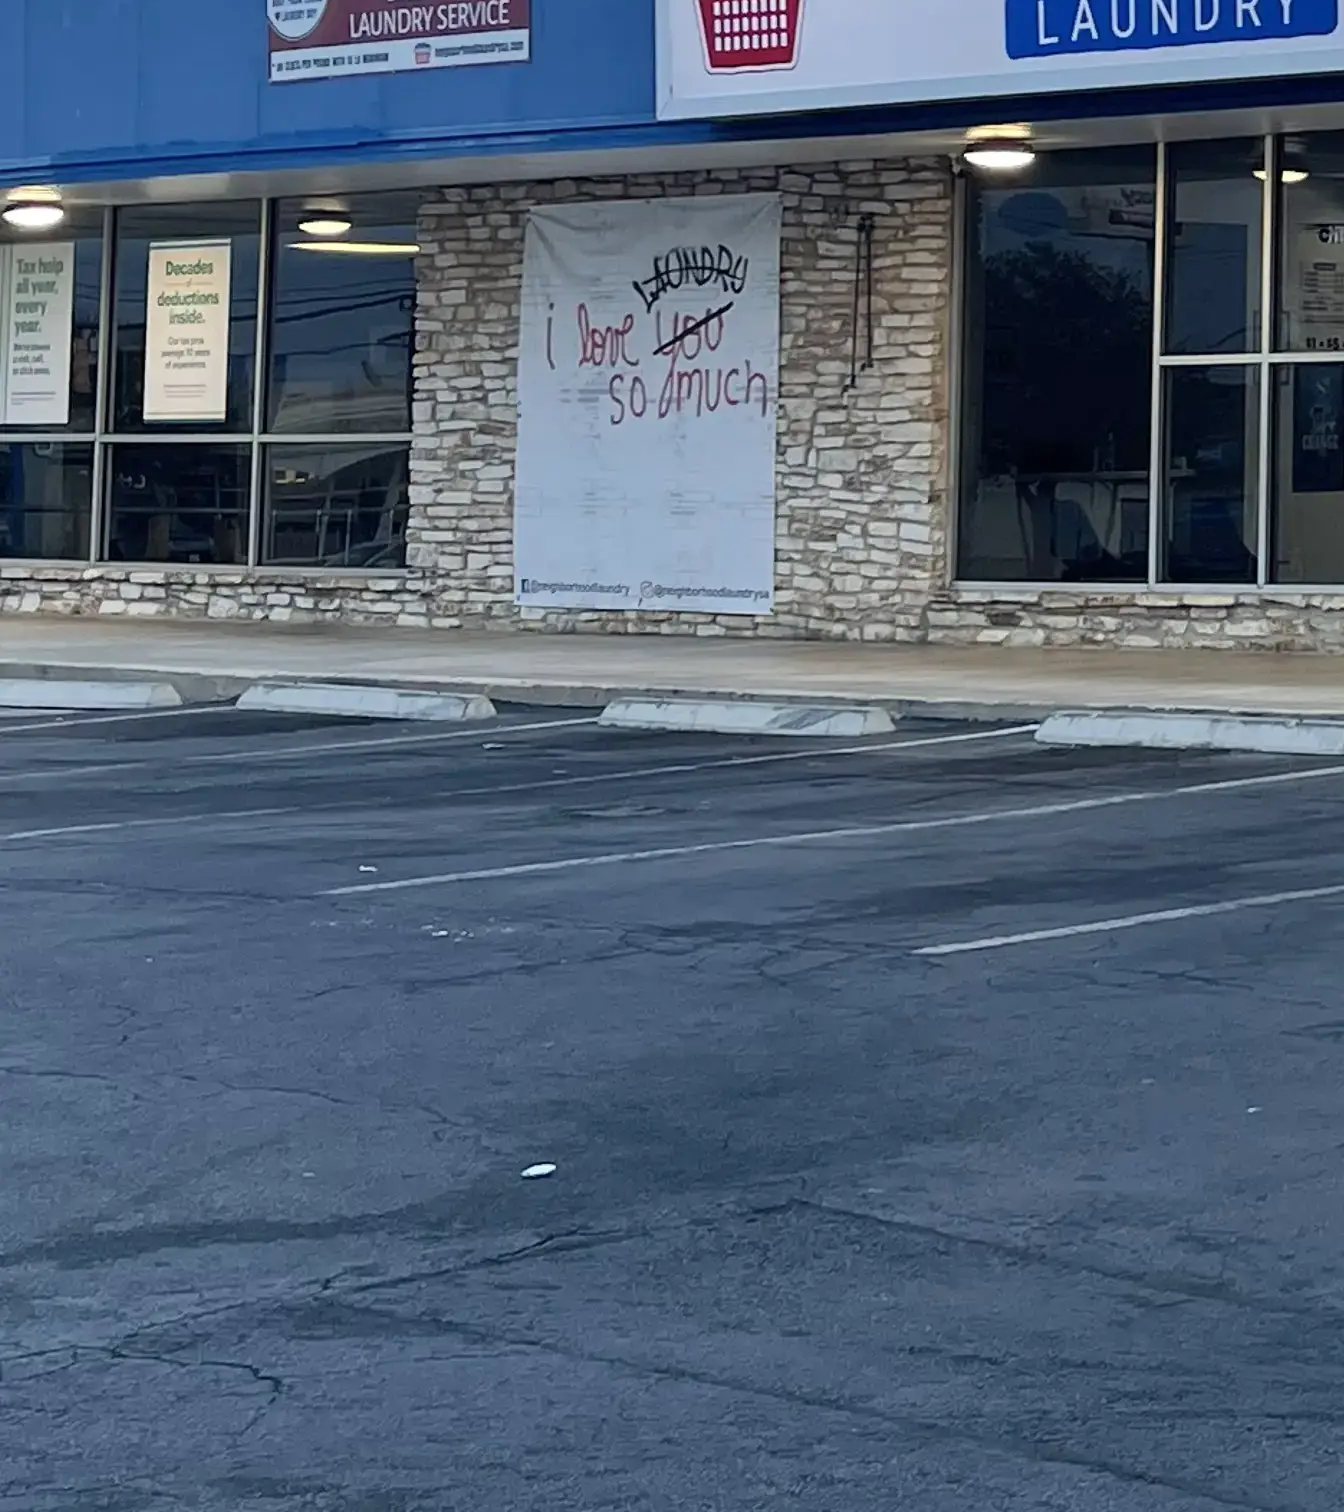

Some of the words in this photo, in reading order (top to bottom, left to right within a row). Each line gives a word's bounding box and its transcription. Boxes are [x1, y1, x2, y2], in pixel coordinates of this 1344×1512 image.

[350, 7, 435, 39] LAUNDRY
[437, 0, 511, 30] SERVICE
[166, 261, 213, 276] Decades
[157, 291, 219, 307] deductions
[169, 311, 206, 325] inside.
[578, 303, 639, 367] love
[610, 373, 646, 425] so
[676, 360, 767, 417] much
